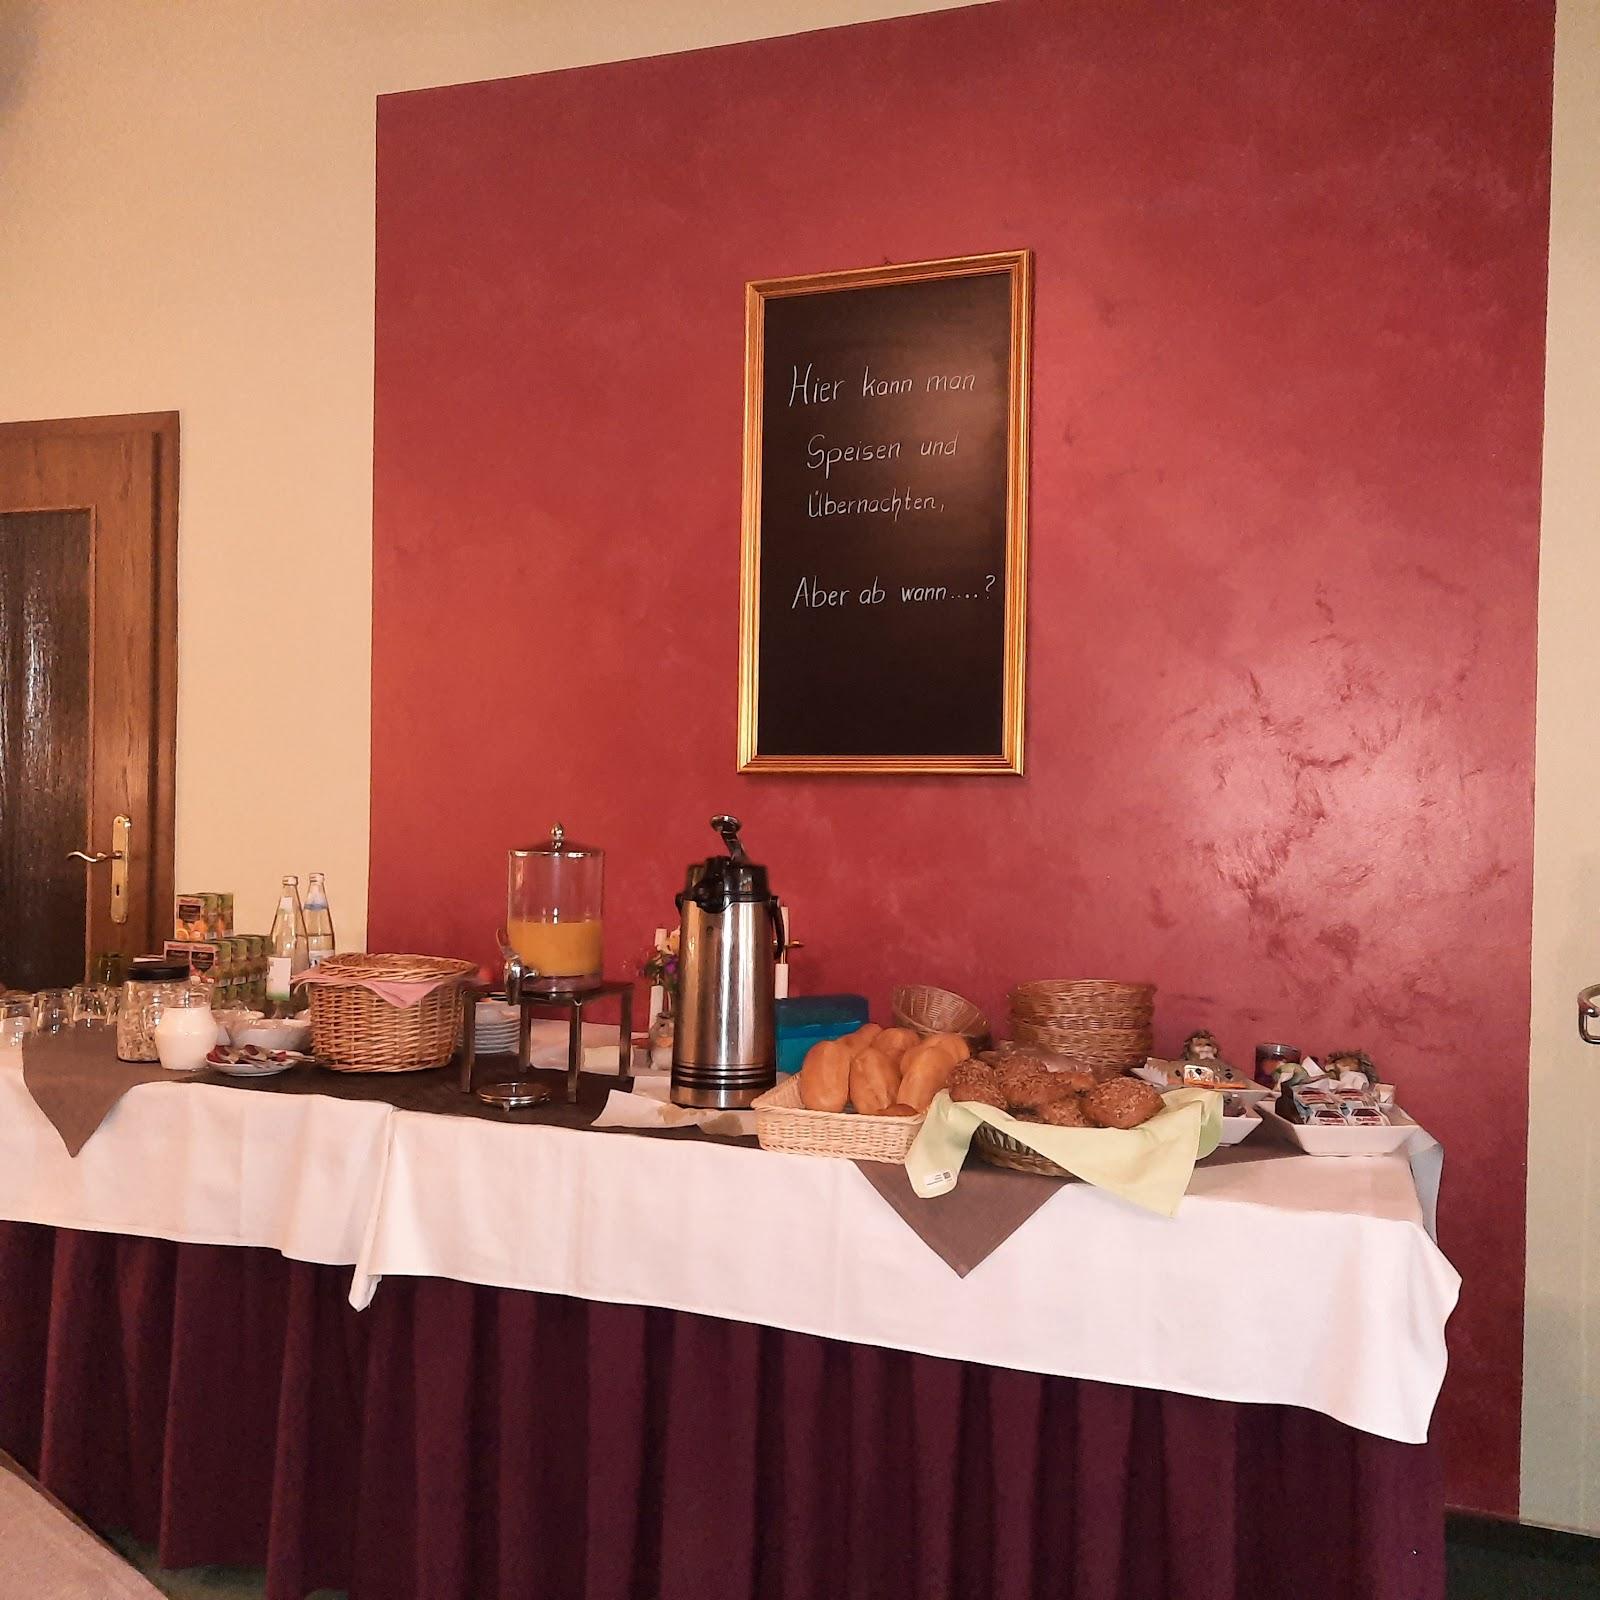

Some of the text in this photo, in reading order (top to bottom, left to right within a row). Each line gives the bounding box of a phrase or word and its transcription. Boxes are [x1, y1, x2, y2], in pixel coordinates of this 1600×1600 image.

[788, 363, 976, 407] Hier kann man
[806, 432, 959, 479] Speisen und
[807, 486, 946, 523] Übernachten,
[791, 575, 851, 610] Aber
[859, 576, 886, 606] ab
